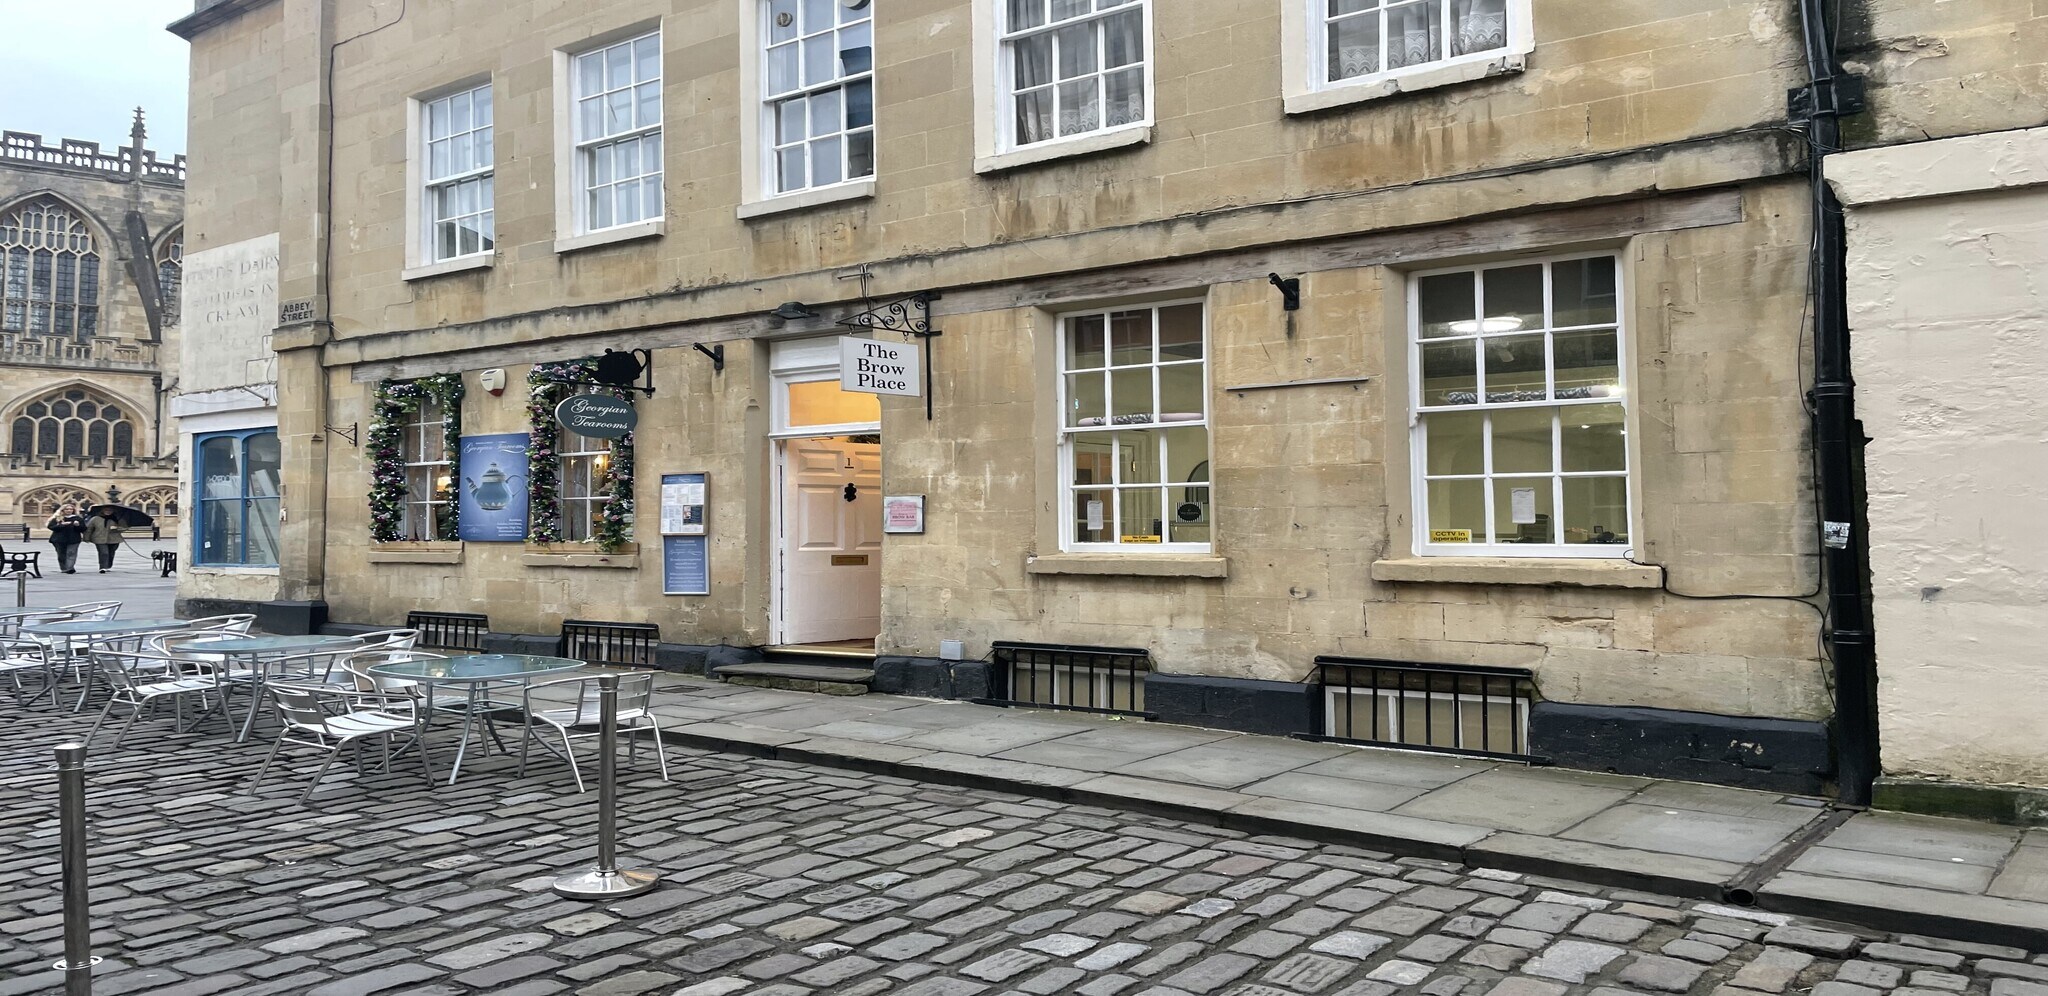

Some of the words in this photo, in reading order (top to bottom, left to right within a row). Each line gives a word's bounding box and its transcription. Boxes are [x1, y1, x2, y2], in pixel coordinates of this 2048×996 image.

[283, 301, 310, 313] ABBEY
[281, 310, 313, 322] STREET
[863, 343, 898, 360] The
[857, 358, 905, 375] Brow
[857, 373, 906, 391] Place
[570, 398, 628, 417] Georgian
[571, 414, 628, 429] Tearooms
